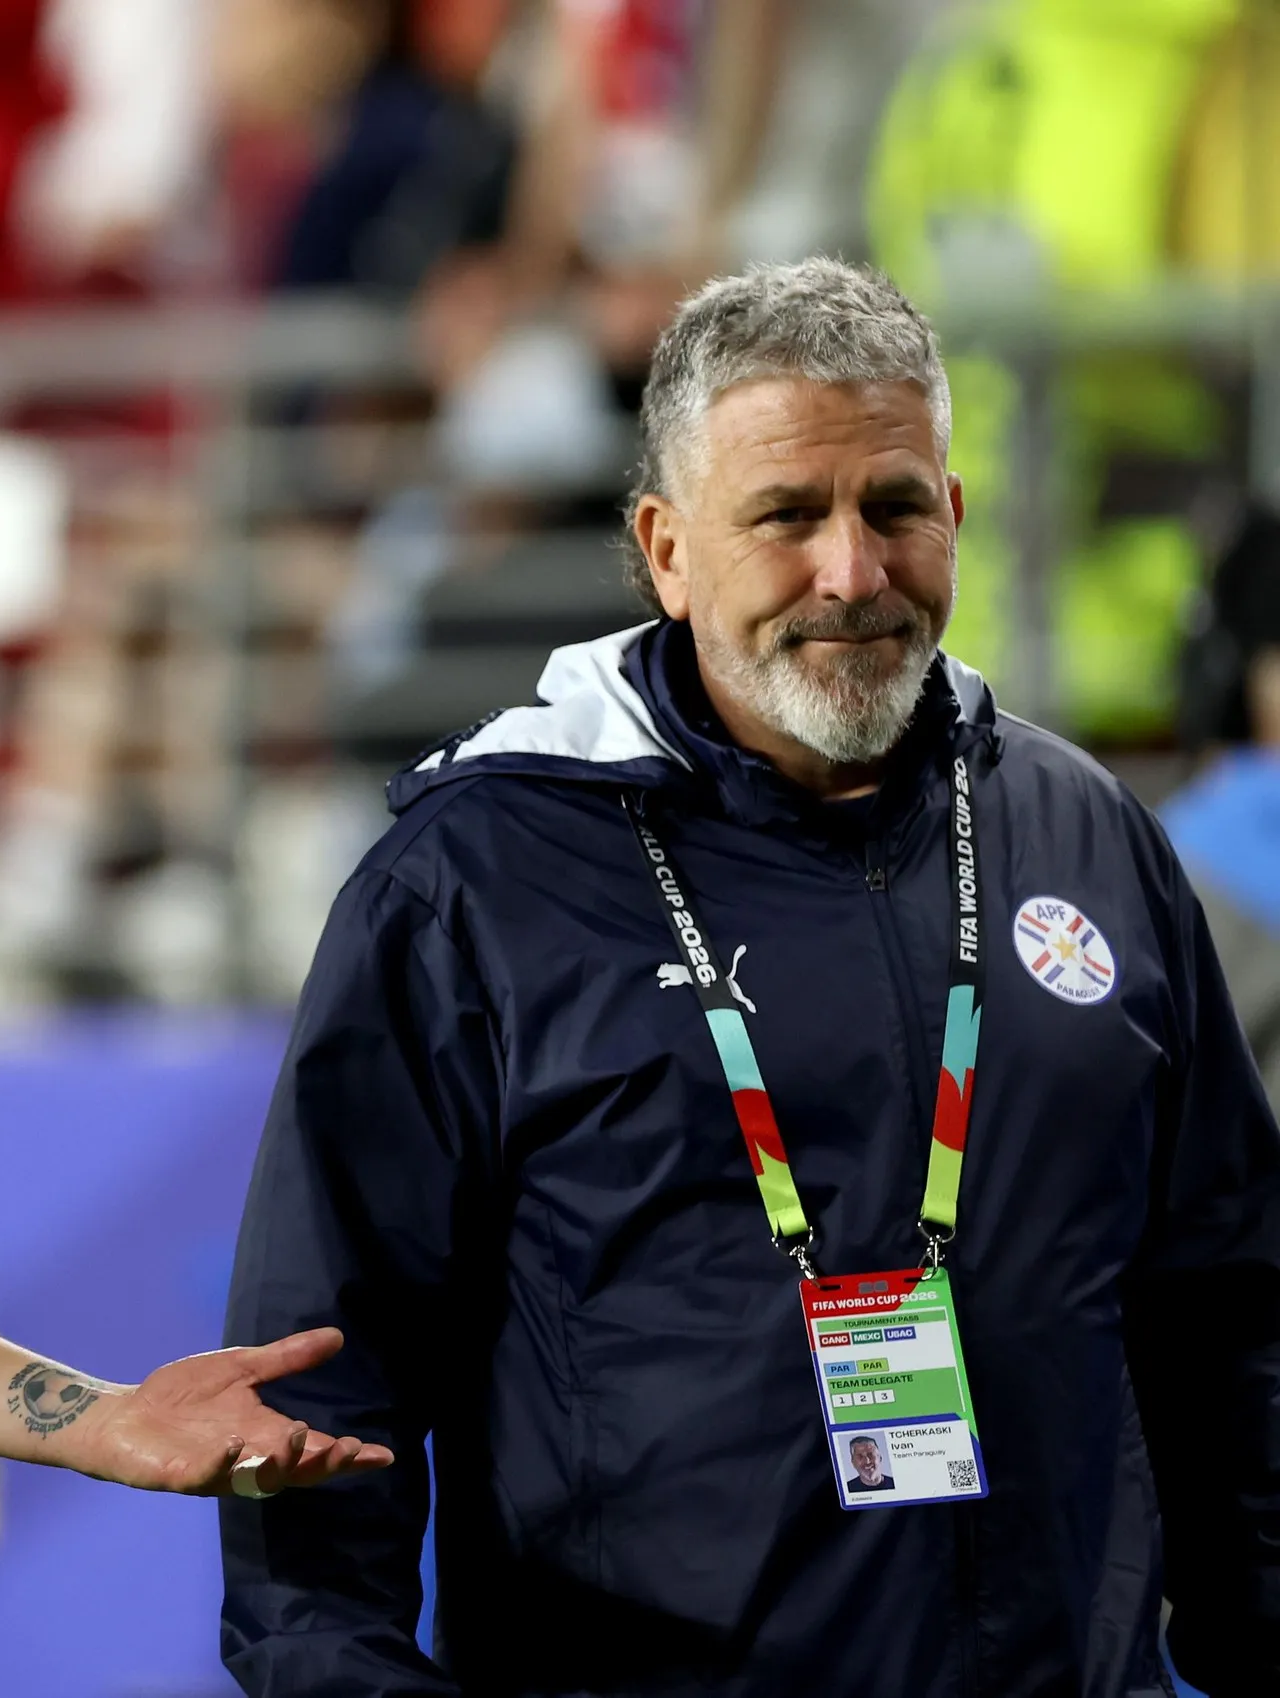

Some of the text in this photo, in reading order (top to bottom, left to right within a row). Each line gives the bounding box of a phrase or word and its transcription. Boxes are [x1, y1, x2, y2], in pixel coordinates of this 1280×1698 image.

[954, 756, 977, 964] FIFA WORLD CUP 20
[1036, 904, 1066, 921] APF
[655, 866, 685, 909] CUP
[672, 910, 717, 984] 2026
[812, 1291, 937, 1311] FIFA WORLD CUP 2026
[844, 1316, 896, 1328] TOURNAMENT
[830, 1361, 882, 1373] PAR PAR
[829, 1374, 914, 1389] TEAM DELEGATE
[860, 1394, 867, 1402] 2
[881, 1392, 888, 1400] 3
[888, 1426, 952, 1439] TCHERKASKI
[890, 1442, 914, 1450] Ivan
